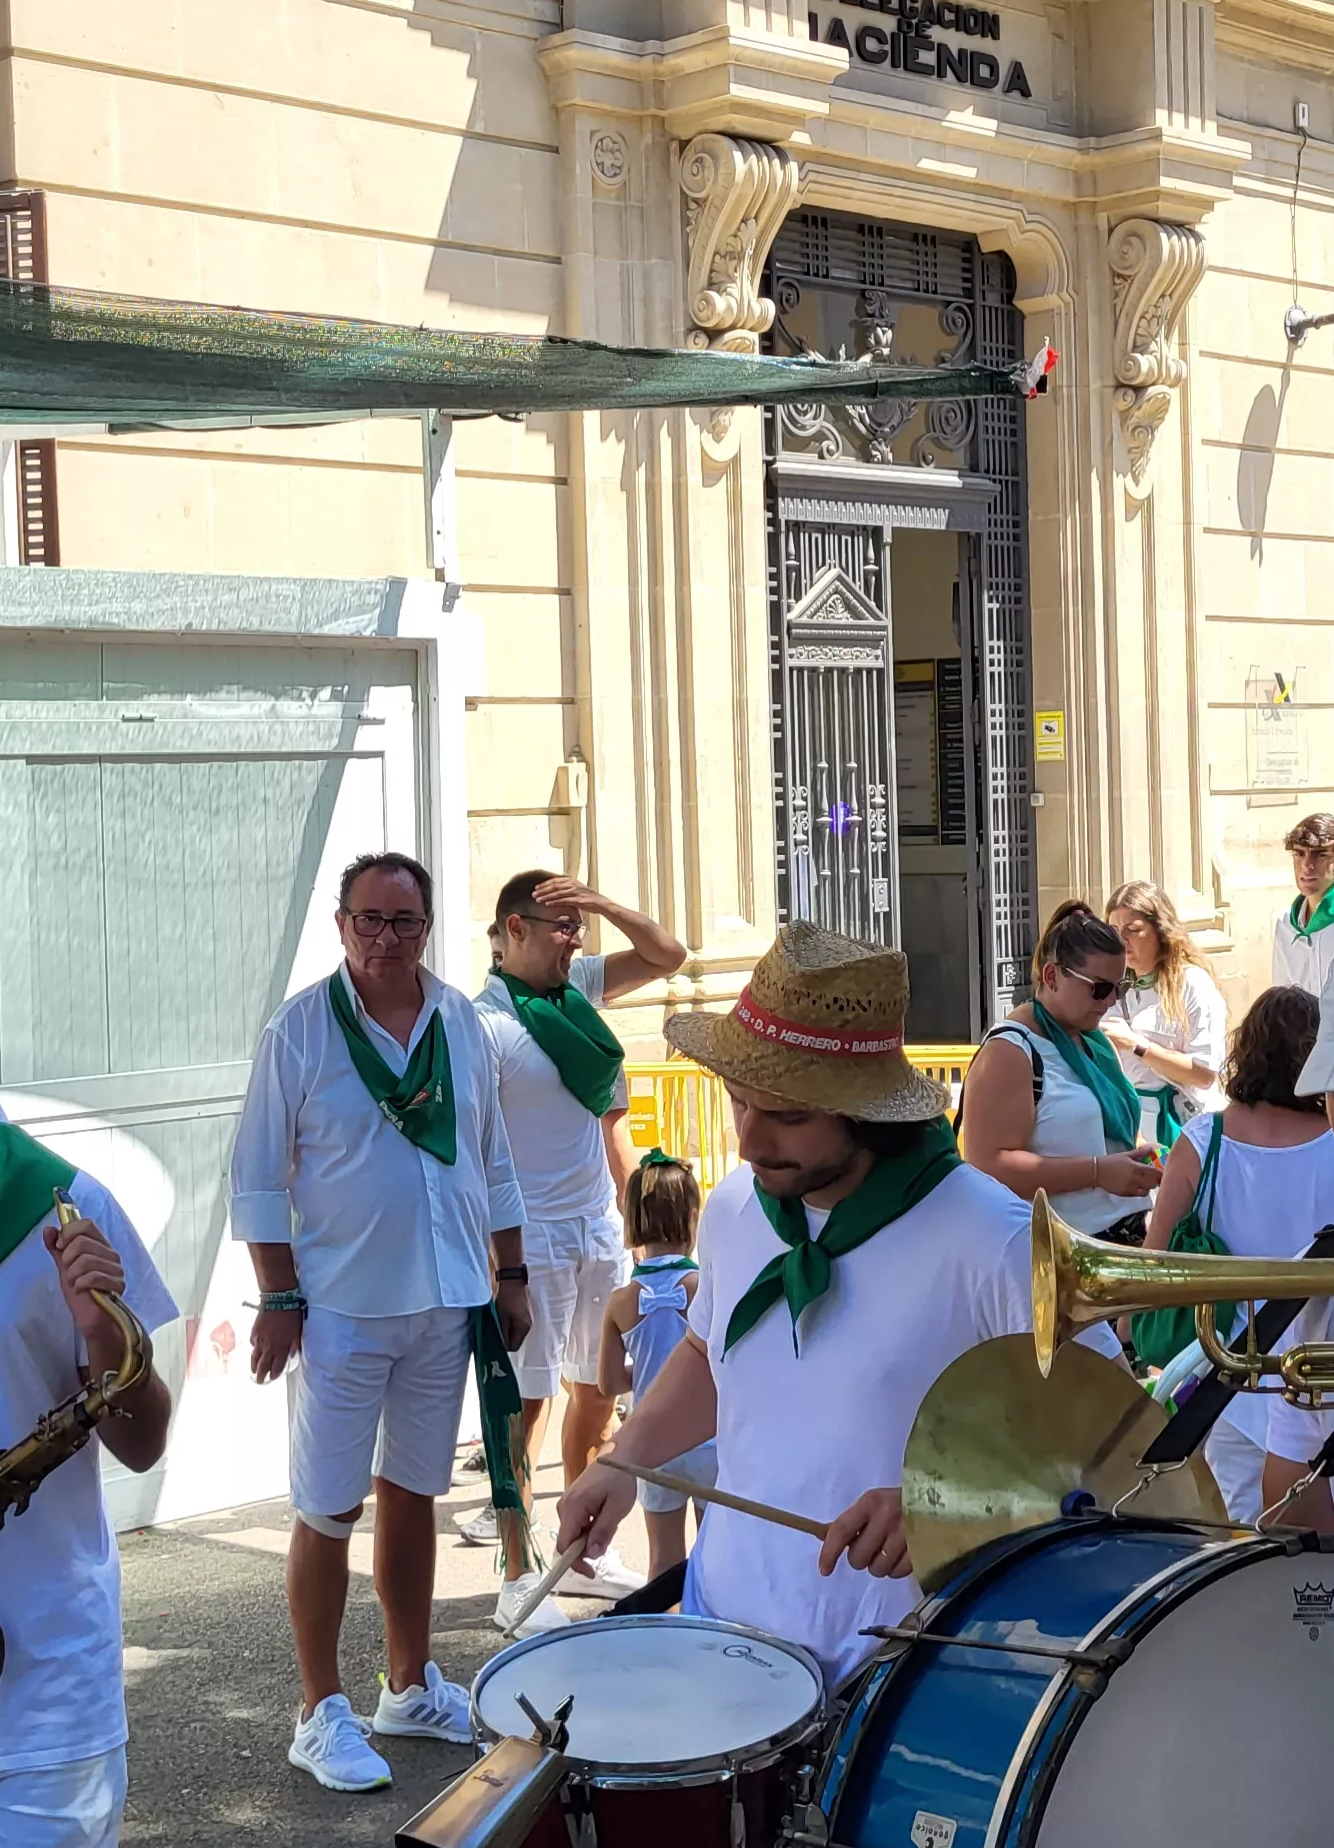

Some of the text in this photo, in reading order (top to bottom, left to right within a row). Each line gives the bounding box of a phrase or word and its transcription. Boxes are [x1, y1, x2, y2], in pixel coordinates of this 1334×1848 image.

[839, 0, 1001, 41] EGACION
[897, 18, 933, 39] DE
[779, 1028, 841, 1051] HERRERO
[1299, 1594, 1331, 1603] REMO
